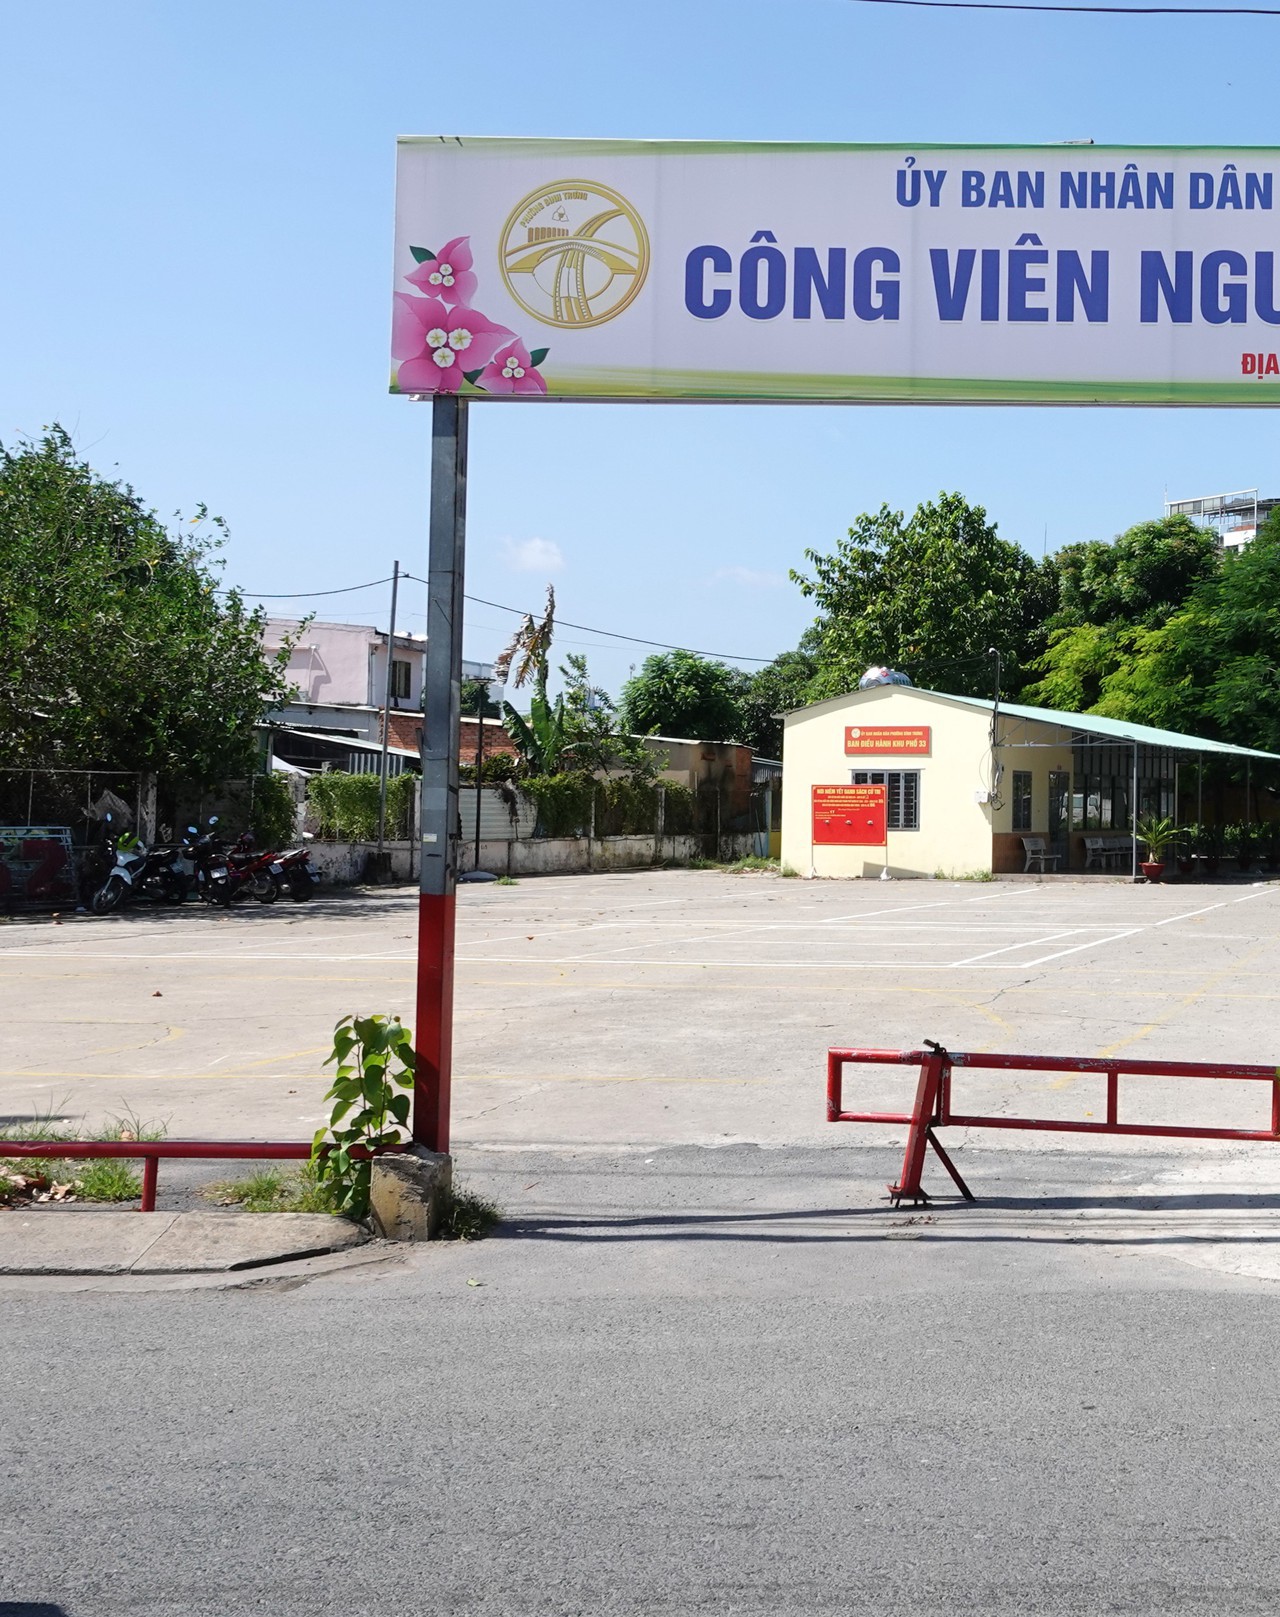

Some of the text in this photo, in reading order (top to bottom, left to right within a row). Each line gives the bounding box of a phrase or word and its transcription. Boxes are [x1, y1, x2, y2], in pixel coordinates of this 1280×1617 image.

[897, 157, 947, 207] ỦY
[962, 171, 1044, 208] BAN
[1060, 164, 1174, 209] NHÂN
[1190, 164, 1272, 210] DÂN
[684, 230, 900, 321] CÔNG
[929, 233, 1109, 323] VIÊN
[1241, 353, 1280, 379] ĐỊA
[906, 738, 918, 747] PHỐ
